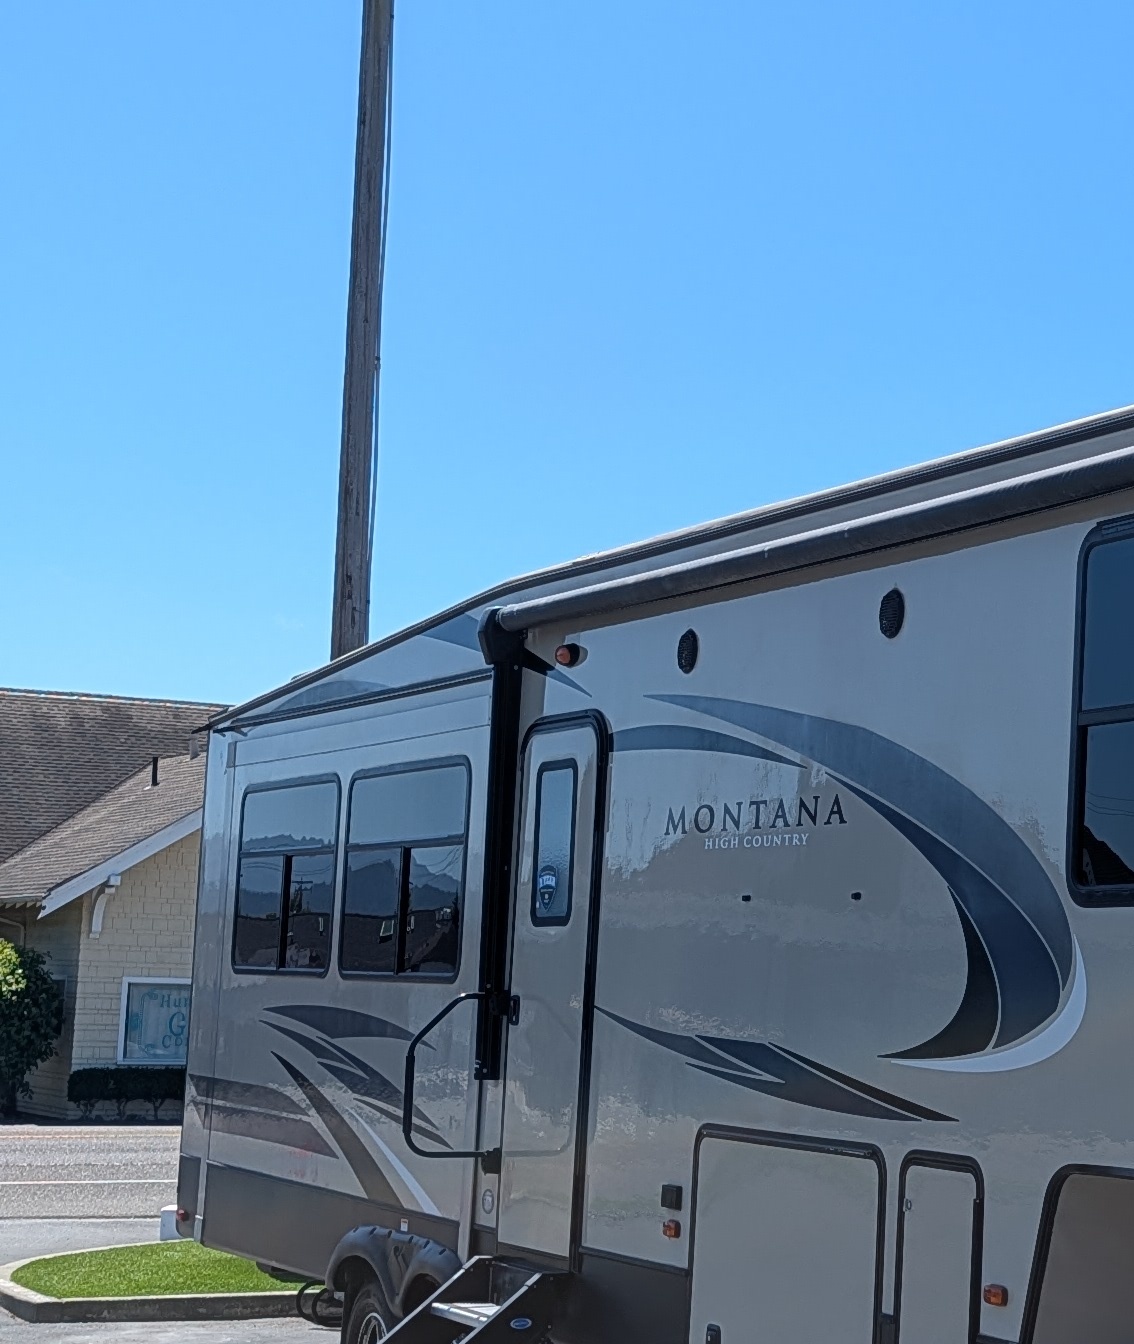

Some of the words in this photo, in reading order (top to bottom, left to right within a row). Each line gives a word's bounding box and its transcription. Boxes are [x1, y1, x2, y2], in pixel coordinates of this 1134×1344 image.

[664, 794, 848, 836] MONTANA
[704, 836, 739, 850] HIGH
[743, 833, 810, 848] COUNTRY
